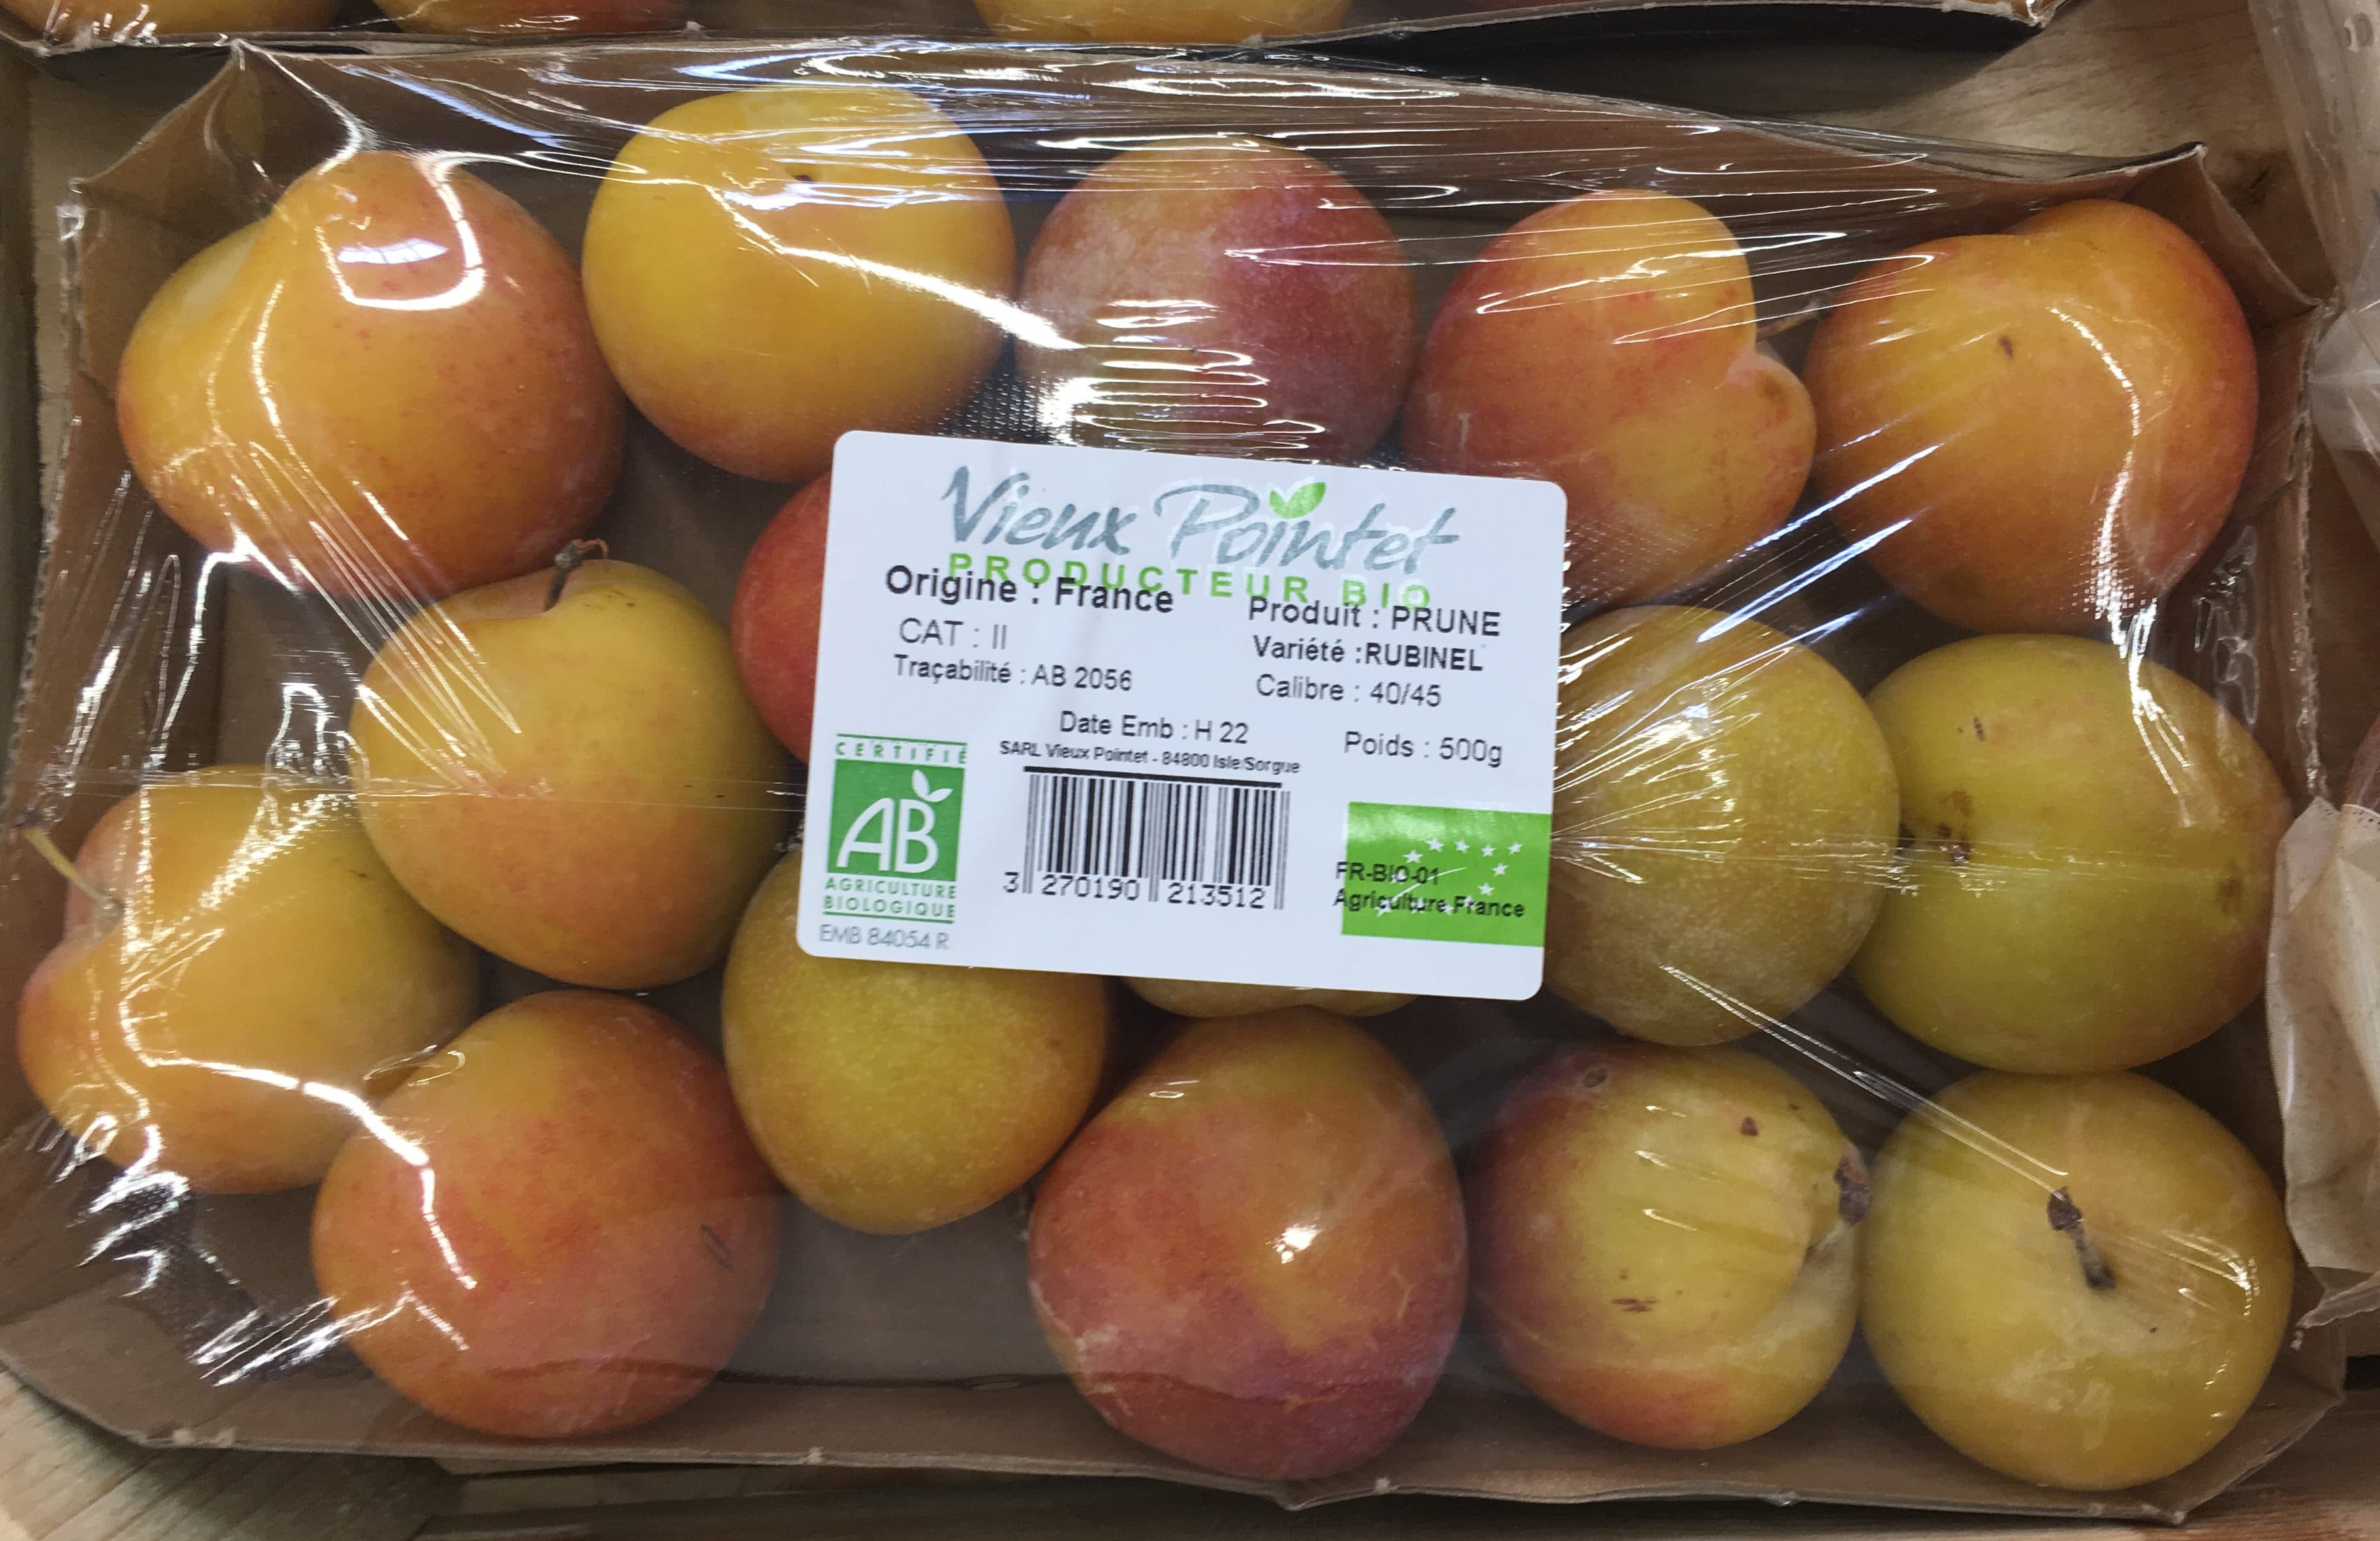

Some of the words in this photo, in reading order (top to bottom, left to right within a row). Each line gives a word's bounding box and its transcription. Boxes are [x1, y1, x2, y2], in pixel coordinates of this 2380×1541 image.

[941, 465, 1138, 555] Vieux
[1153, 480, 1461, 576] Pointet
[886, 563, 1018, 606] Origine
[1054, 576, 1174, 614] France
[950, 552, 1309, 604] PRODUCTEUR
[1341, 578, 1430, 611] BIO
[898, 617, 963, 647] CAT
[1249, 595, 1362, 627] Produit
[1390, 605, 1501, 637] PRUNE
[1253, 634, 1345, 663] Variété
[894, 653, 1012, 683] Traçabilité
[1031, 664, 1067, 687] AB
[1074, 666, 1133, 692] 2056
[1256, 673, 1345, 702] Calibre
[1370, 681, 1442, 708] 40/45
[1059, 710, 1113, 735] Date
[1121, 714, 1174, 739] Emb
[1194, 720, 1213, 742] H
[1219, 721, 1249, 745] 22
[999, 740, 1042, 757] SARL
[1044, 743, 1090, 760] Vieux
[1093, 746, 1149, 764] Pointet
[1161, 751, 1210, 768] 84800
[1344, 730, 1415, 758] Poids
[1439, 736, 1503, 768] 500g
[836, 797, 940, 874] AB
[824, 876, 958, 899] AGRICULTURE
[1336, 860, 1440, 885] FR-BIO-01
[822, 895, 957, 918] BIOLOGIQUE
[1002, 871, 1020, 894] 3
[1041, 873, 1140, 901] 270190
[1167, 882, 1268, 911] 213512
[1332, 888, 1448, 912] Agriculture
[1453, 894, 1526, 918] France
[819, 924, 862, 944] EMB
[867, 927, 931, 948] 84054
